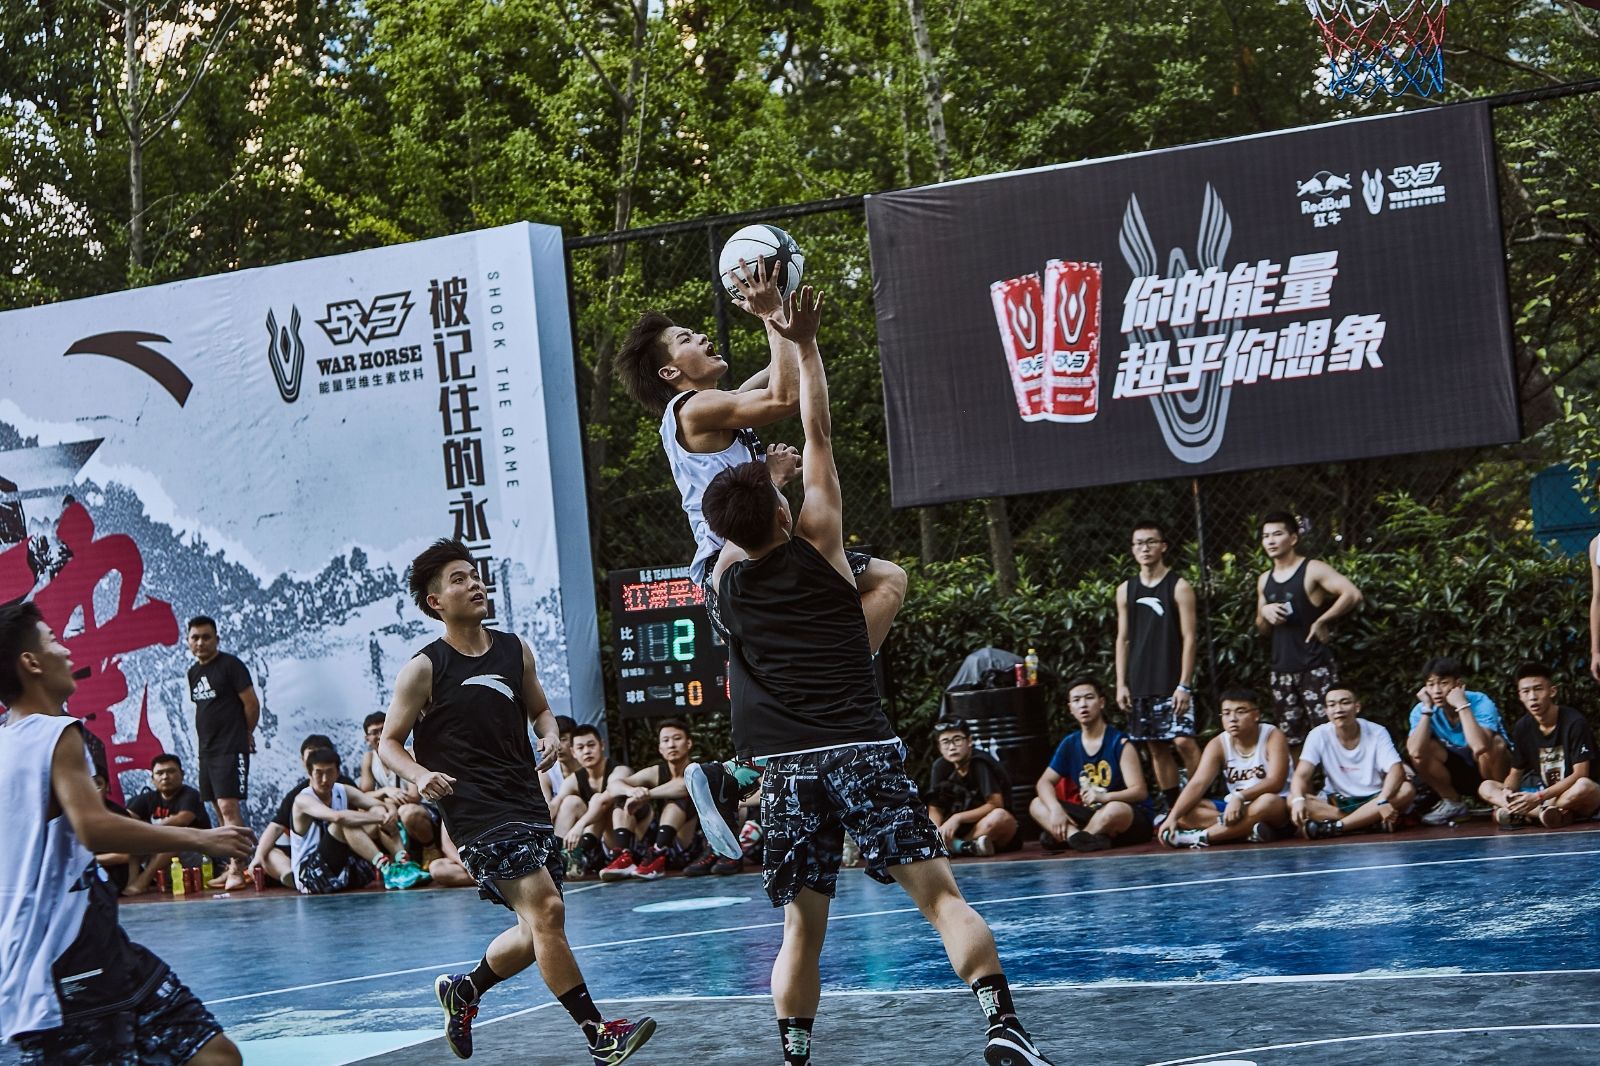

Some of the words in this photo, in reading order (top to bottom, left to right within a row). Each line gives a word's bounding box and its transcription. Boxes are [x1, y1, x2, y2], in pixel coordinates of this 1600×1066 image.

[1313, 211, 1341, 228] 红牛
[488, 271, 506, 348] SHOCK
[1120, 250, 1339, 333] 你的能量
[316, 355, 357, 376] WAR
[359, 344, 422, 369] HORSE
[1112, 314, 1387, 399] 超乎你想象
[319, 367, 424, 394] 能量型维生素饮料
[496, 367, 511, 408] THE
[502, 427, 519, 488] GAME
[687, 680, 703, 706] 0
